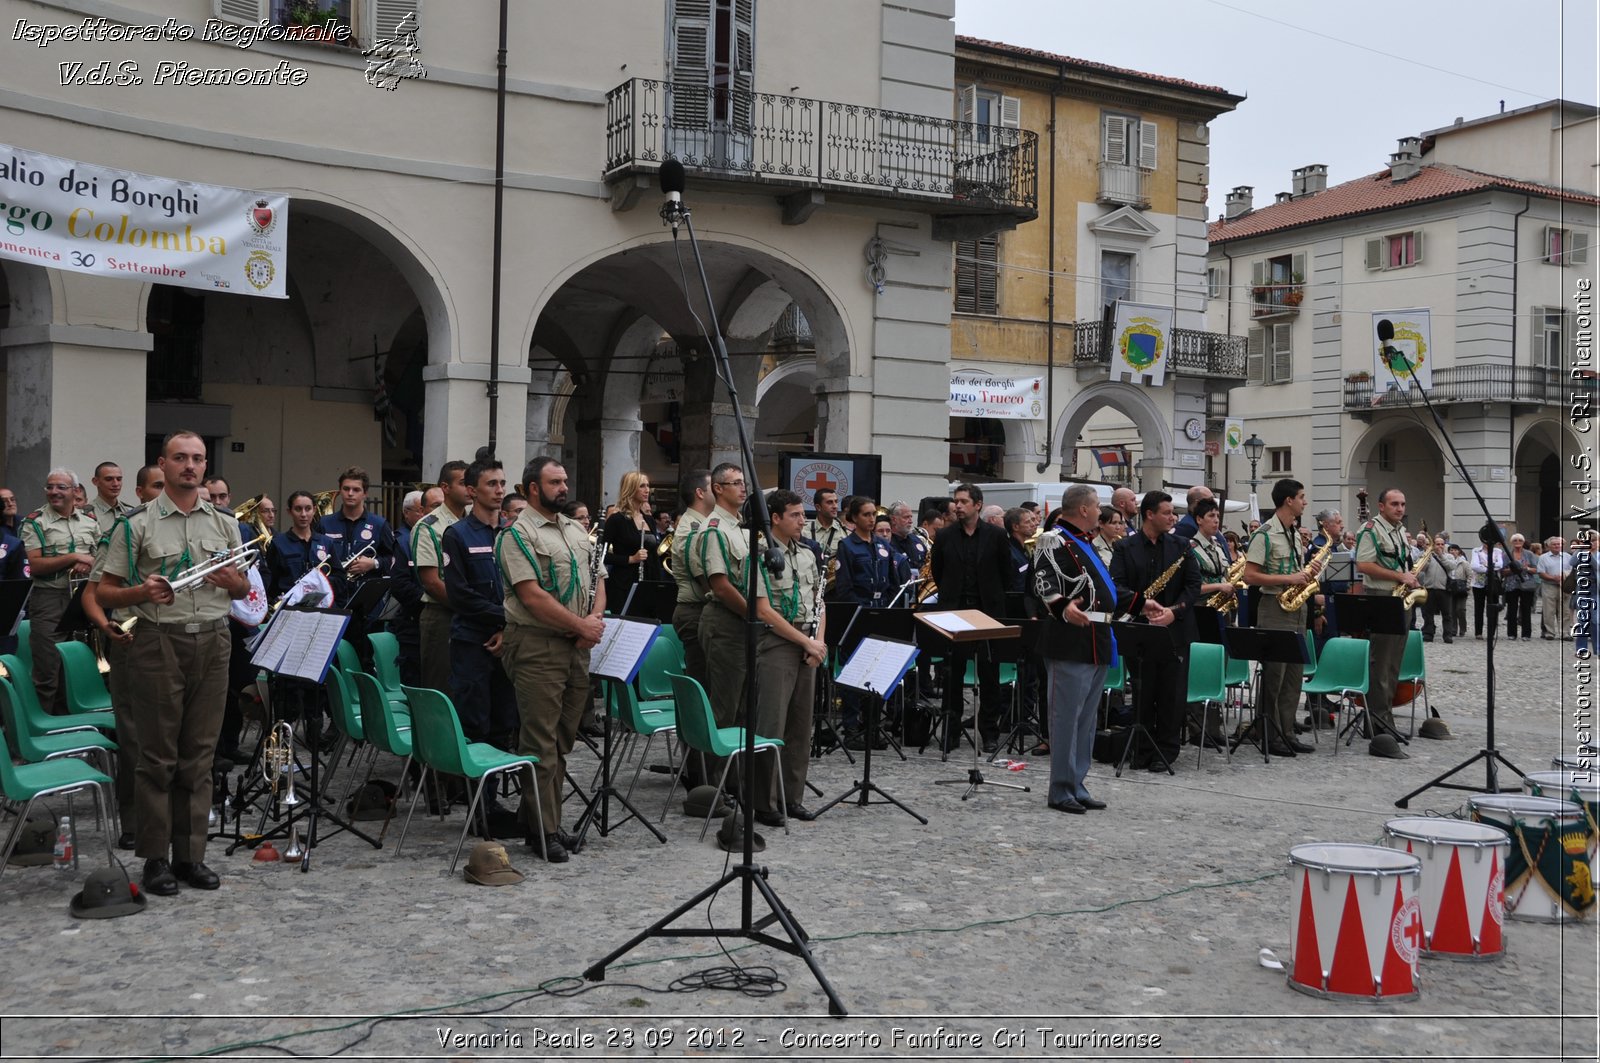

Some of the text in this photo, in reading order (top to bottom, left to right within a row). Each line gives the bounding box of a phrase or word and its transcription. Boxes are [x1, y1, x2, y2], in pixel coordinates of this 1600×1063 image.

[59, 169, 98, 199] dei
[111, 178, 199, 217] Borghi
[67, 207, 227, 257] Colomba
[70, 250, 96, 269] 30
[107, 257, 187, 280] Settembre
[969, 377, 982, 387] dei
[985, 377, 1015, 390] Borghi
[979, 390, 1024, 405] Trucco
